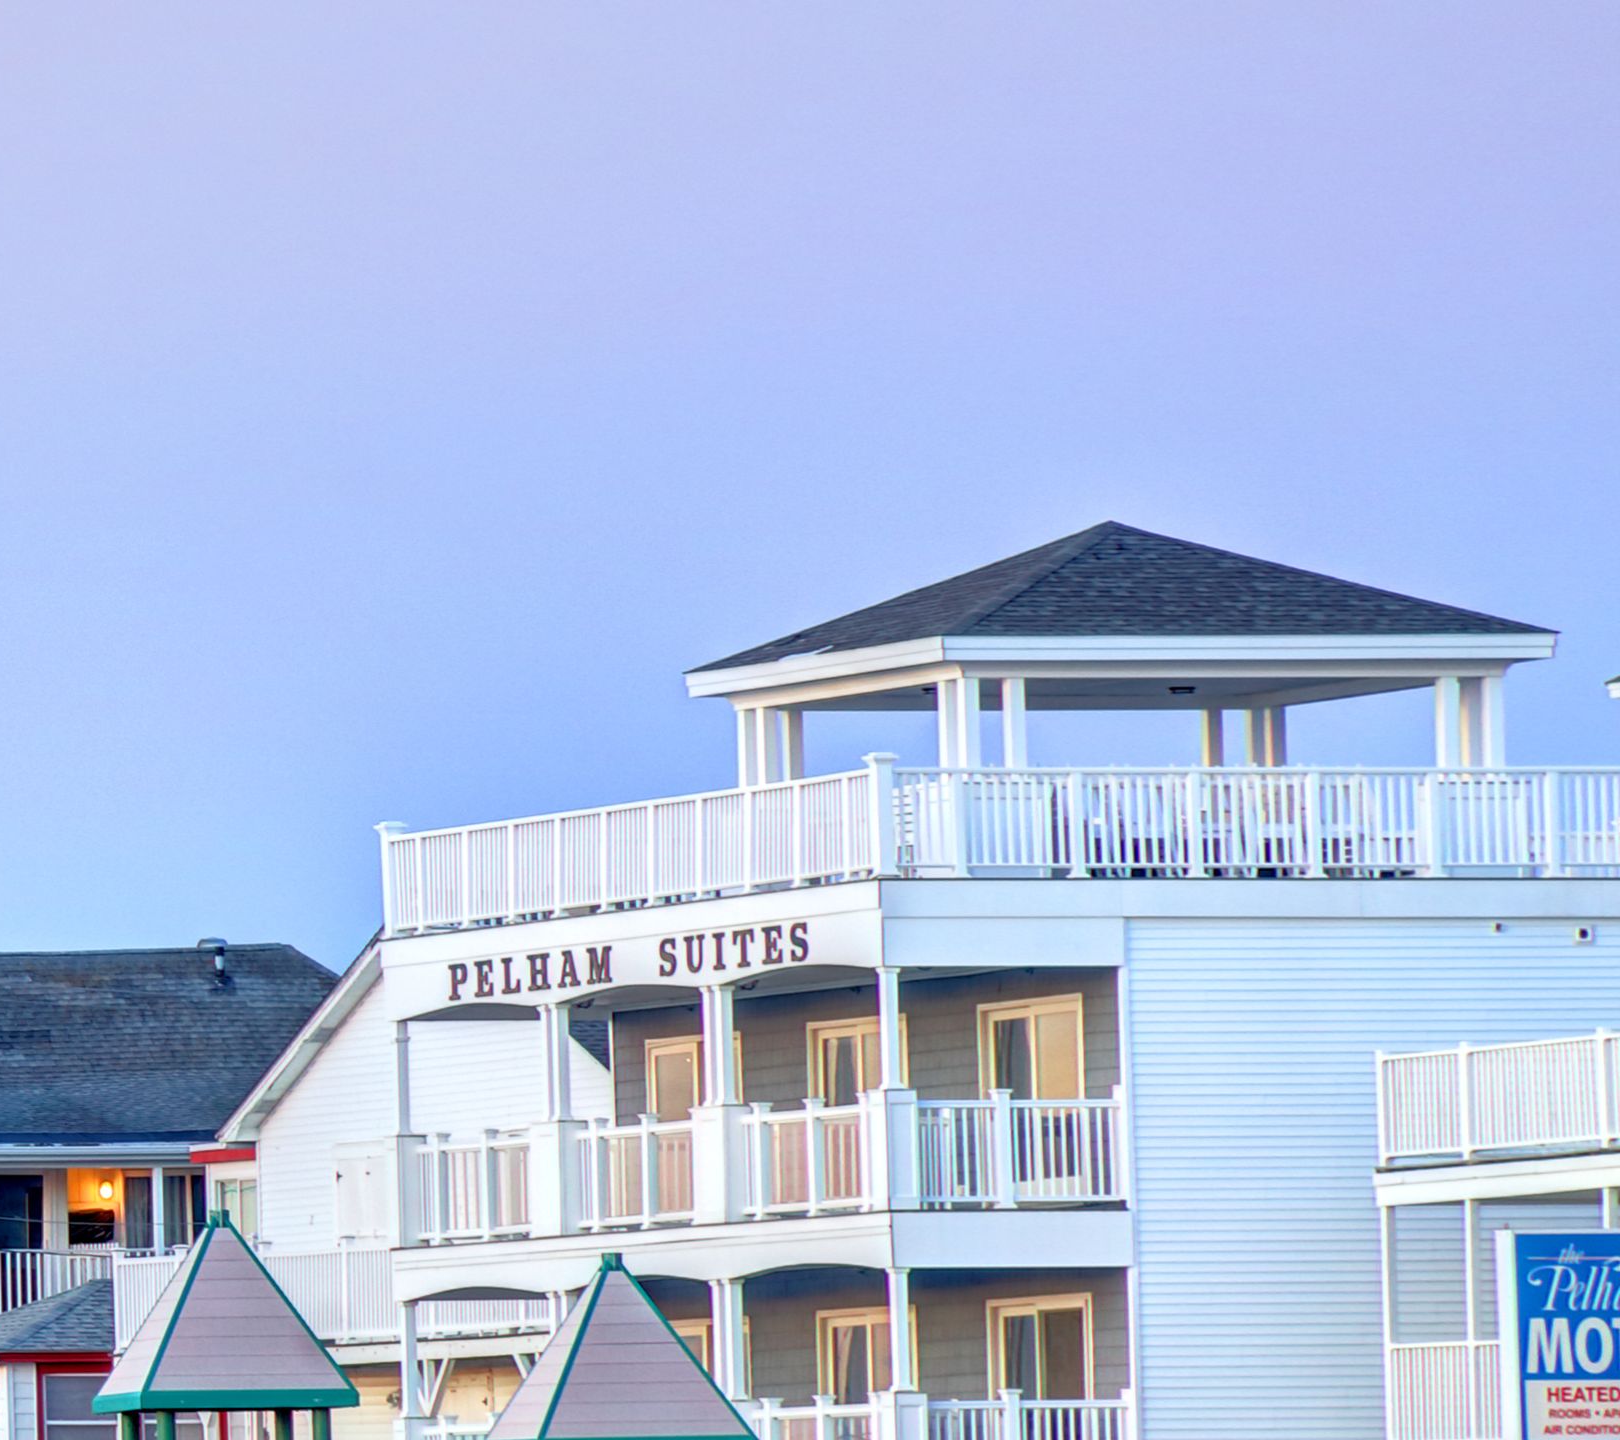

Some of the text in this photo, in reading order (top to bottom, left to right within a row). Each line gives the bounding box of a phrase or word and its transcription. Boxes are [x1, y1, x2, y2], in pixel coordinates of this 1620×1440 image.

[447, 922, 810, 1001] PELHAM SUITES
[1546, 1386, 1620, 1403] HEATED
[1548, 1409, 1591, 1418] ROOMS
